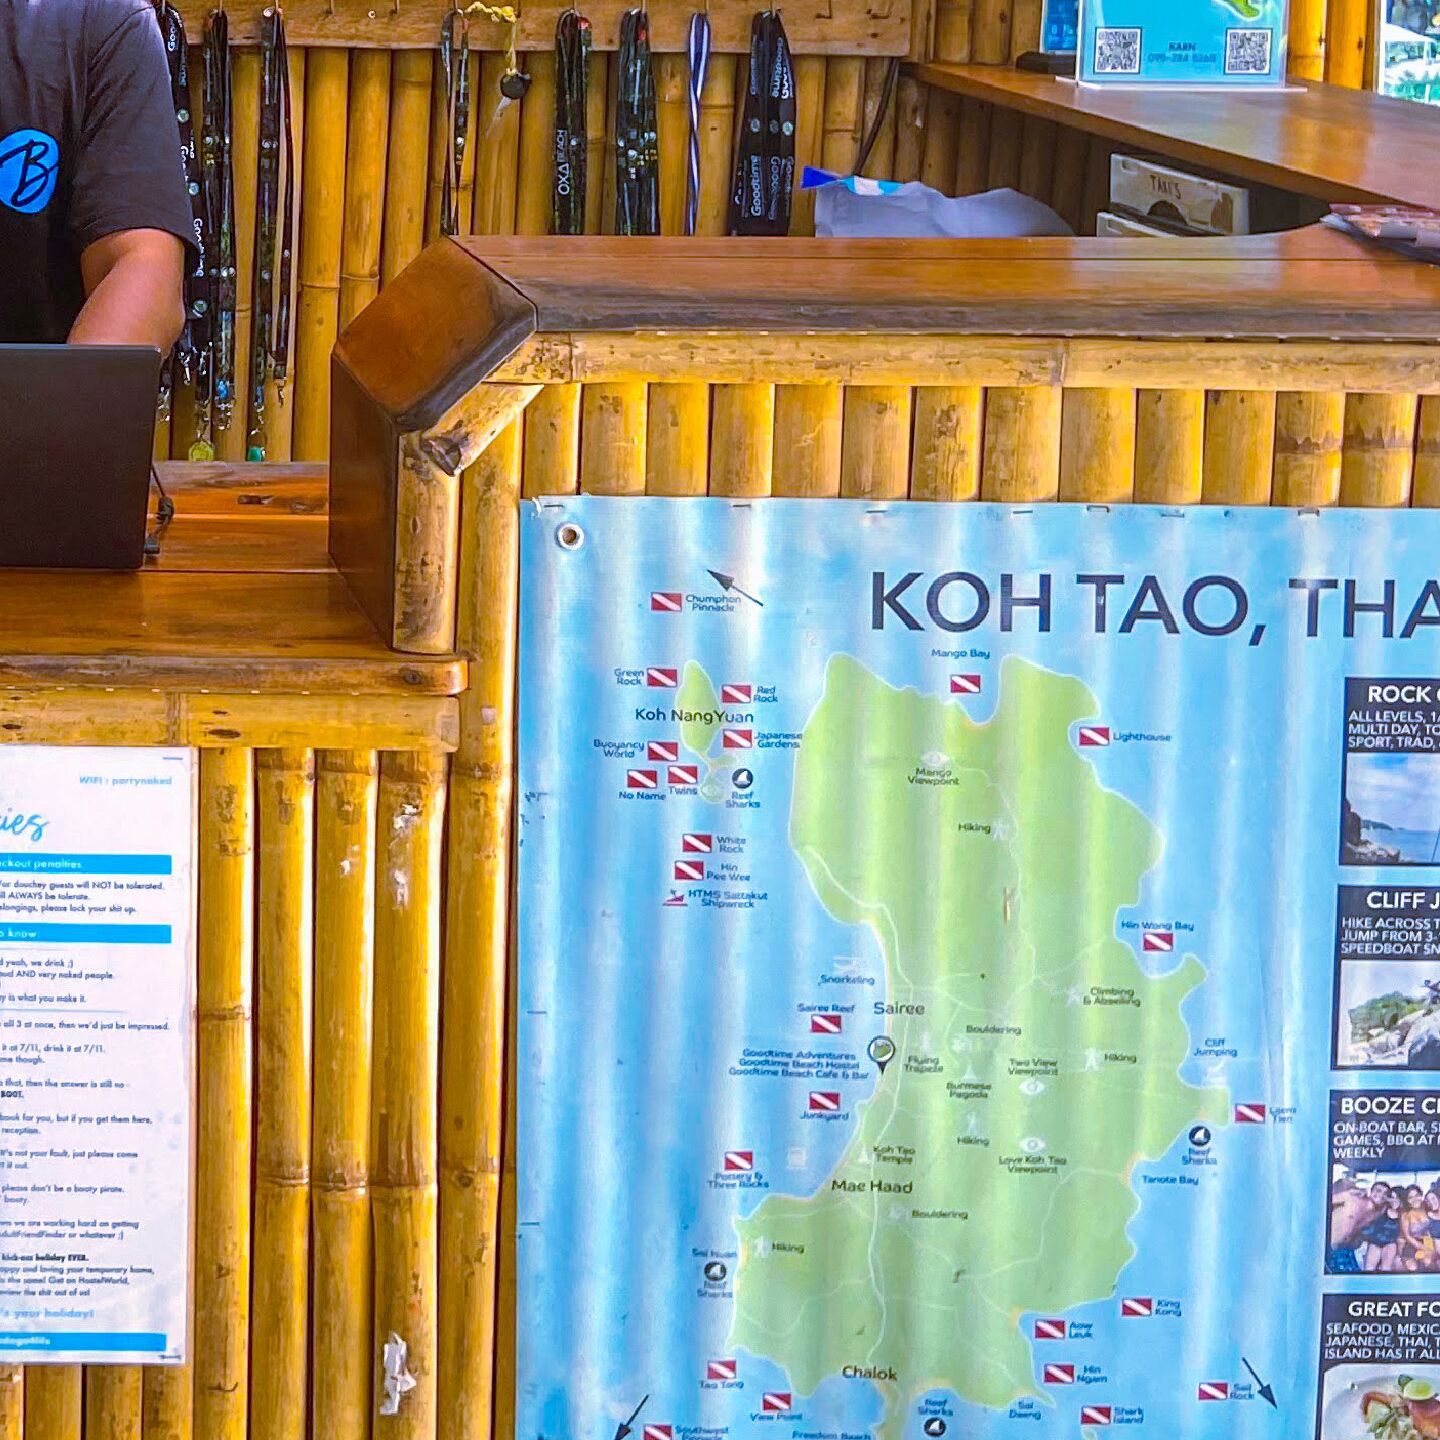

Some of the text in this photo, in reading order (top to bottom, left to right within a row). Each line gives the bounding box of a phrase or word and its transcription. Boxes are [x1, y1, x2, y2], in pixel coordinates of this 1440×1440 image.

[872, 570, 1052, 634] KOH
[1076, 574, 1267, 647] TAO,
[932, 648, 990, 660] Mango Bay
[1368, 685, 1432, 703] ROCK
[635, 707, 667, 723] Koh
[1348, 710, 1427, 724] ALL LEVELS,
[1113, 731, 1173, 744] Lighthouse
[1366, 891, 1426, 909] CLIFF
[1342, 917, 1431, 930] HIKE ACROSS
[874, 1001, 925, 1015] Sairee
[1341, 1096, 1416, 1115] BOOZE
[1332, 1147, 1386, 1159] WEEKLY
[831, 1179, 914, 1194] Mae Haad
[1348, 1301, 1413, 1318] GREAT
[1324, 1348, 1416, 1360] ISLAND HAS IT
[842, 1364, 898, 1382] Chalok
